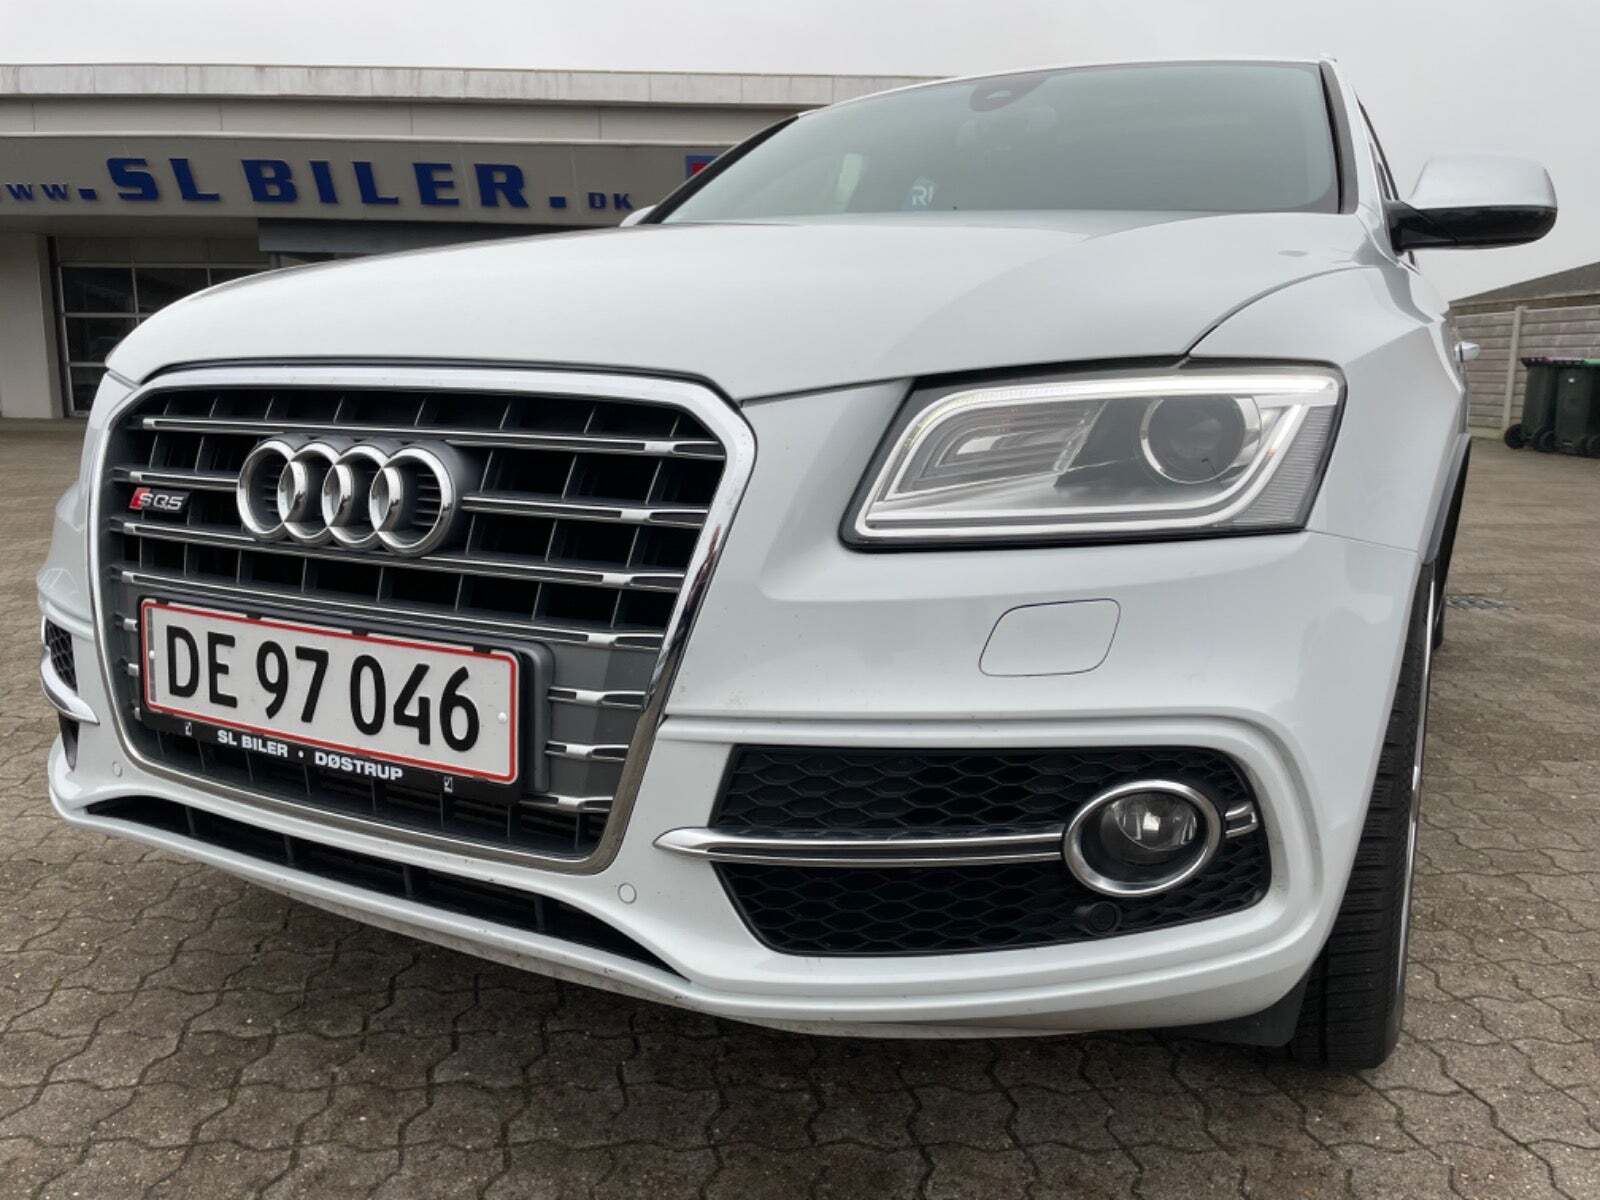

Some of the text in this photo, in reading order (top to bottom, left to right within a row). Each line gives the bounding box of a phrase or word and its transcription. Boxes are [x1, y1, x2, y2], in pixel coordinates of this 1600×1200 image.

[138, 493, 184, 510] SQ5
[166, 625, 480, 752] DE 97 046
[217, 730, 403, 780] SL BILER DØSTRUP
